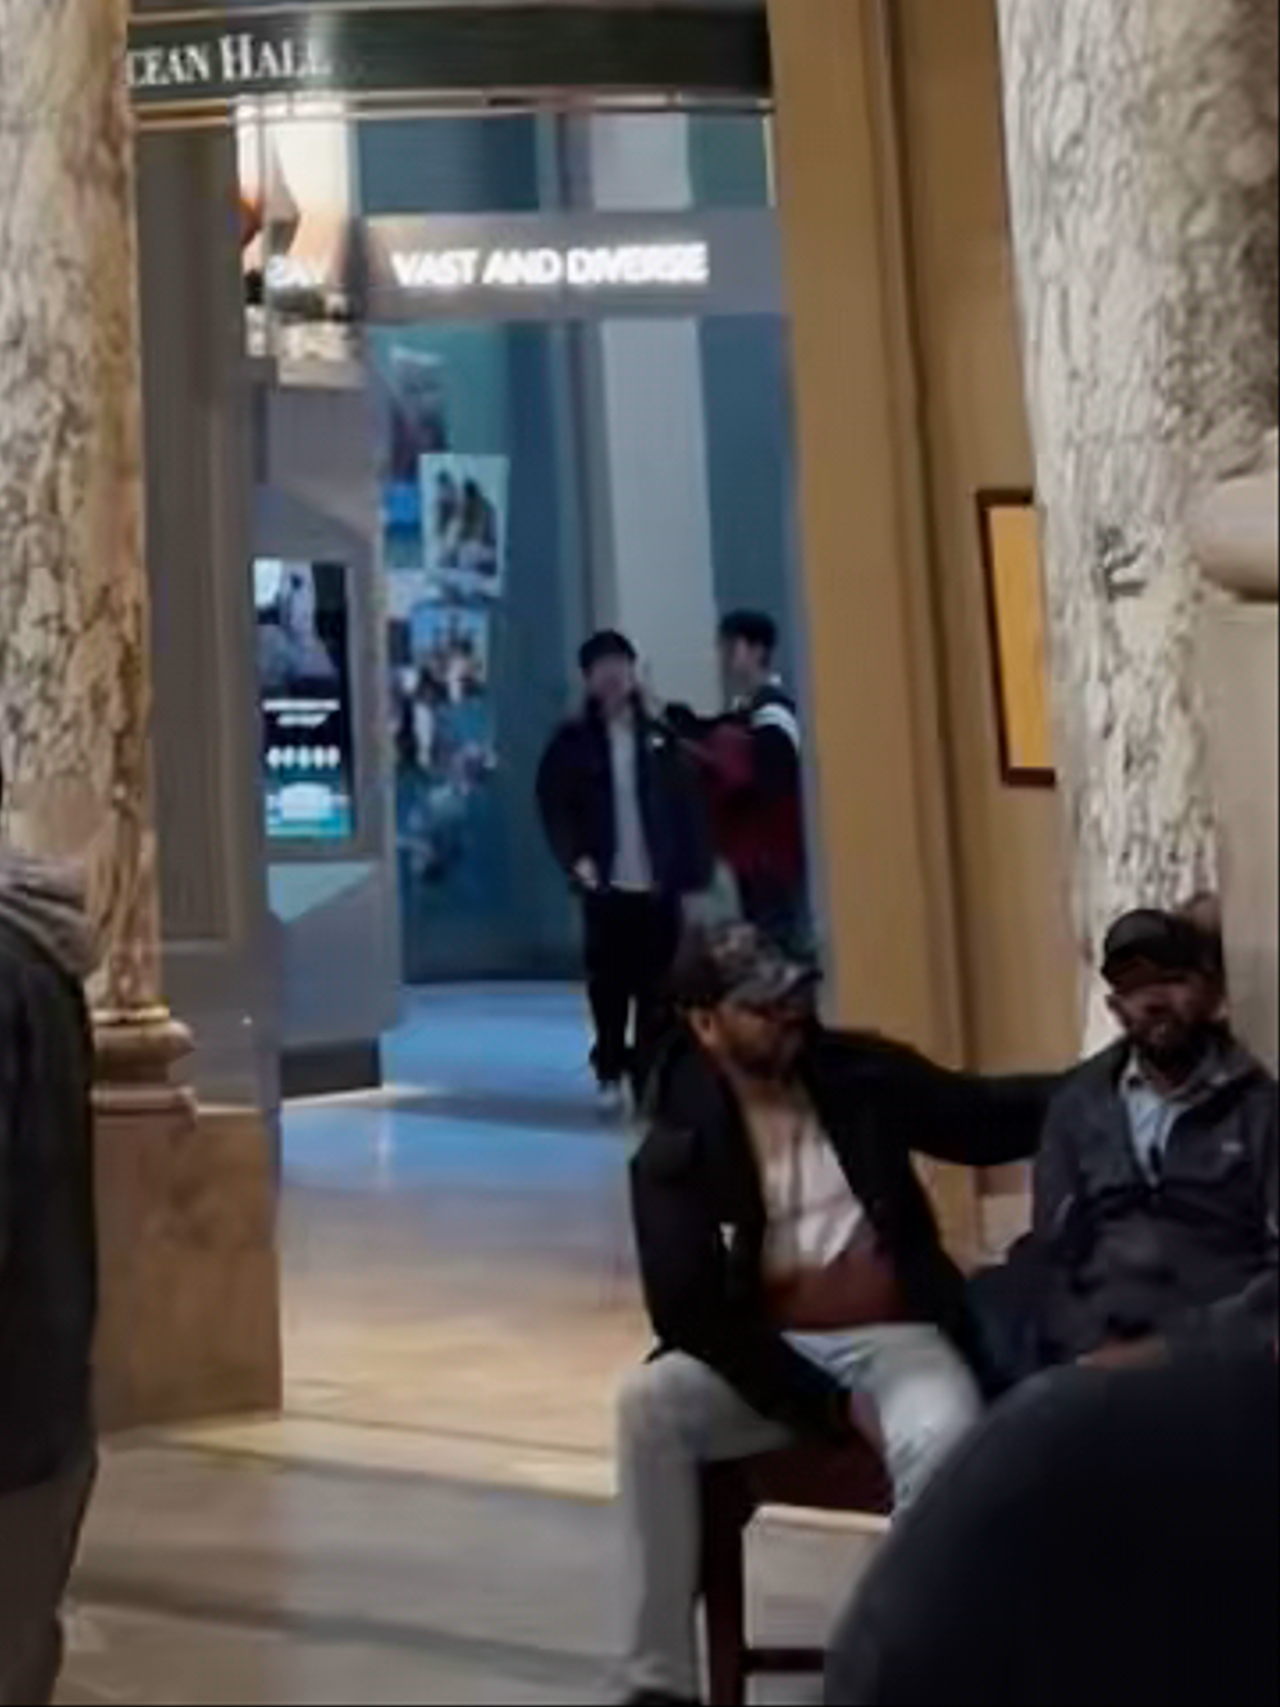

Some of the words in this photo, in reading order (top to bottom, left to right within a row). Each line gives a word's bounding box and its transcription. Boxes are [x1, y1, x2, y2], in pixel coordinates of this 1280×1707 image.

[126, 43, 212, 86] CEAN
[219, 33, 333, 83] HALL
[390, 250, 479, 286] VAST
[482, 248, 564, 285] AND
[566, 241, 710, 285] DIVERSE
